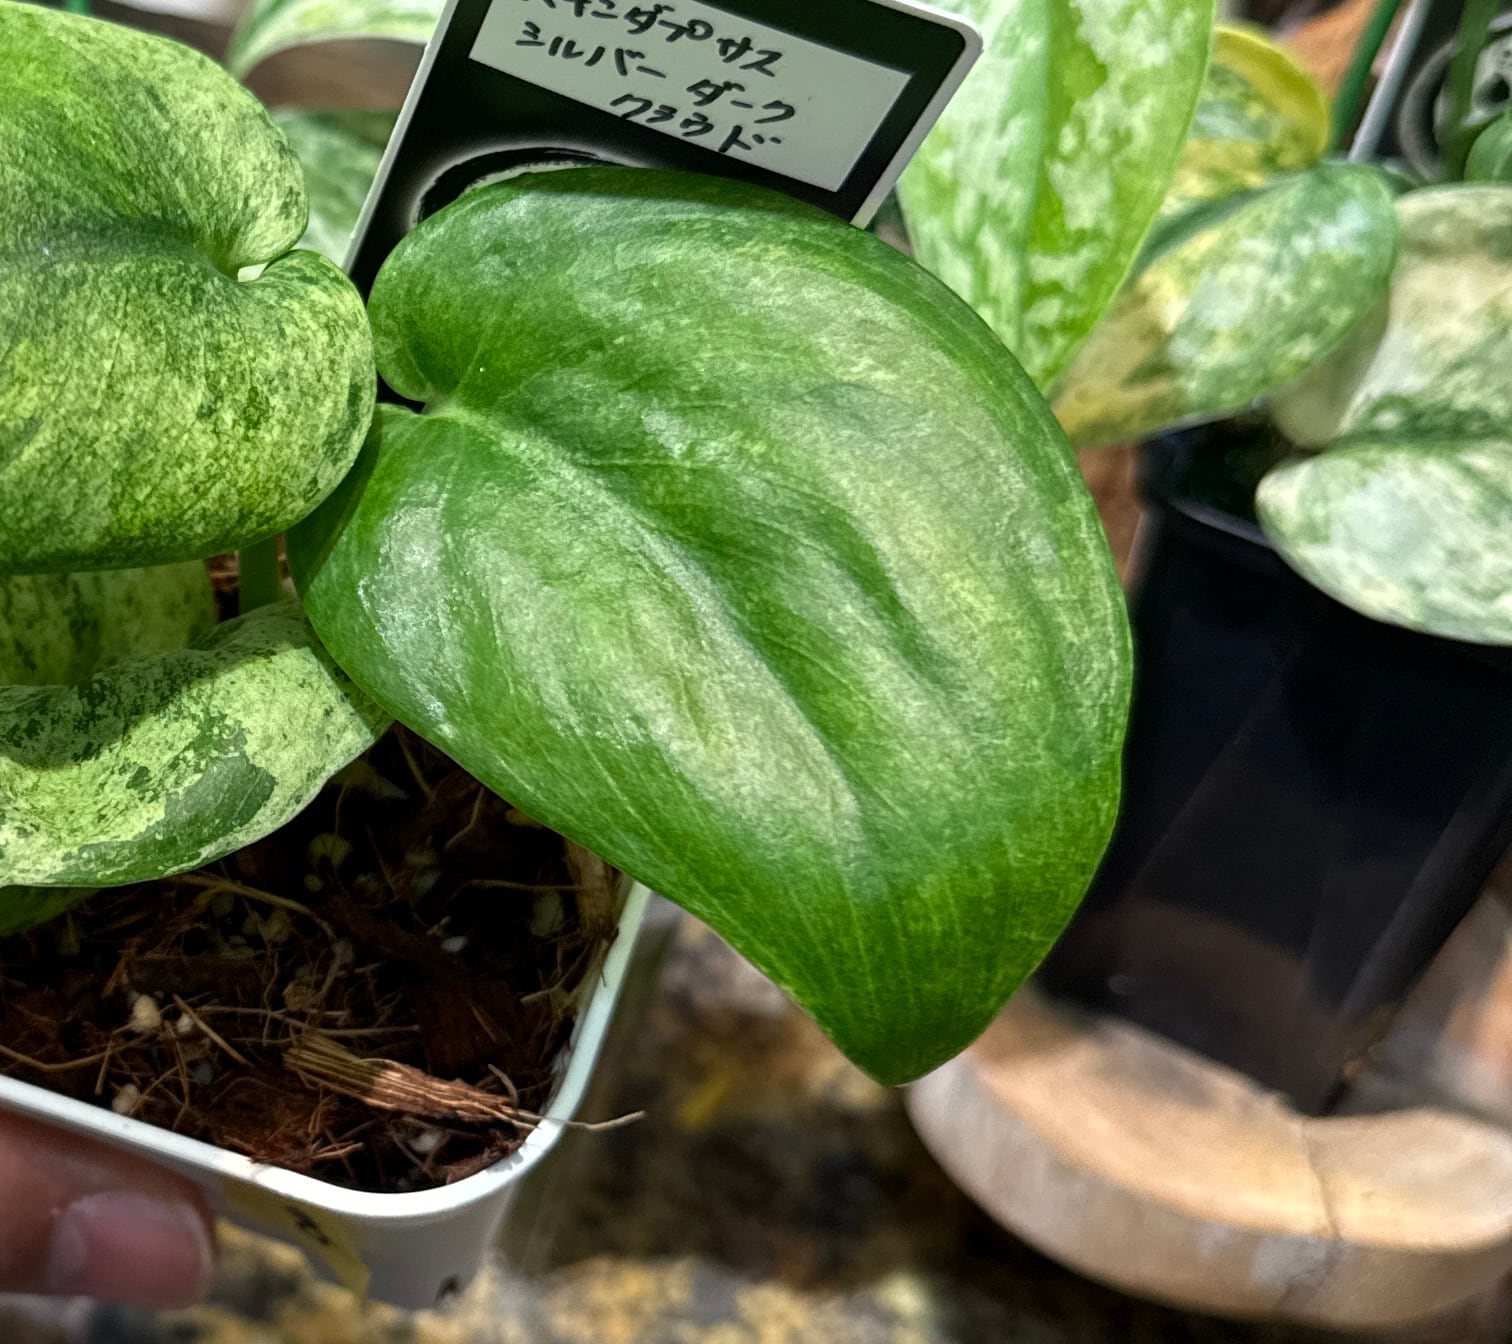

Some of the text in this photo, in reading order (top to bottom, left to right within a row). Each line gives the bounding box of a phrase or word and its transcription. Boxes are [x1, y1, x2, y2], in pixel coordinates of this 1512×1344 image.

[609, 93, 783, 154] クラウド
[686, 79, 796, 125] ダーク
